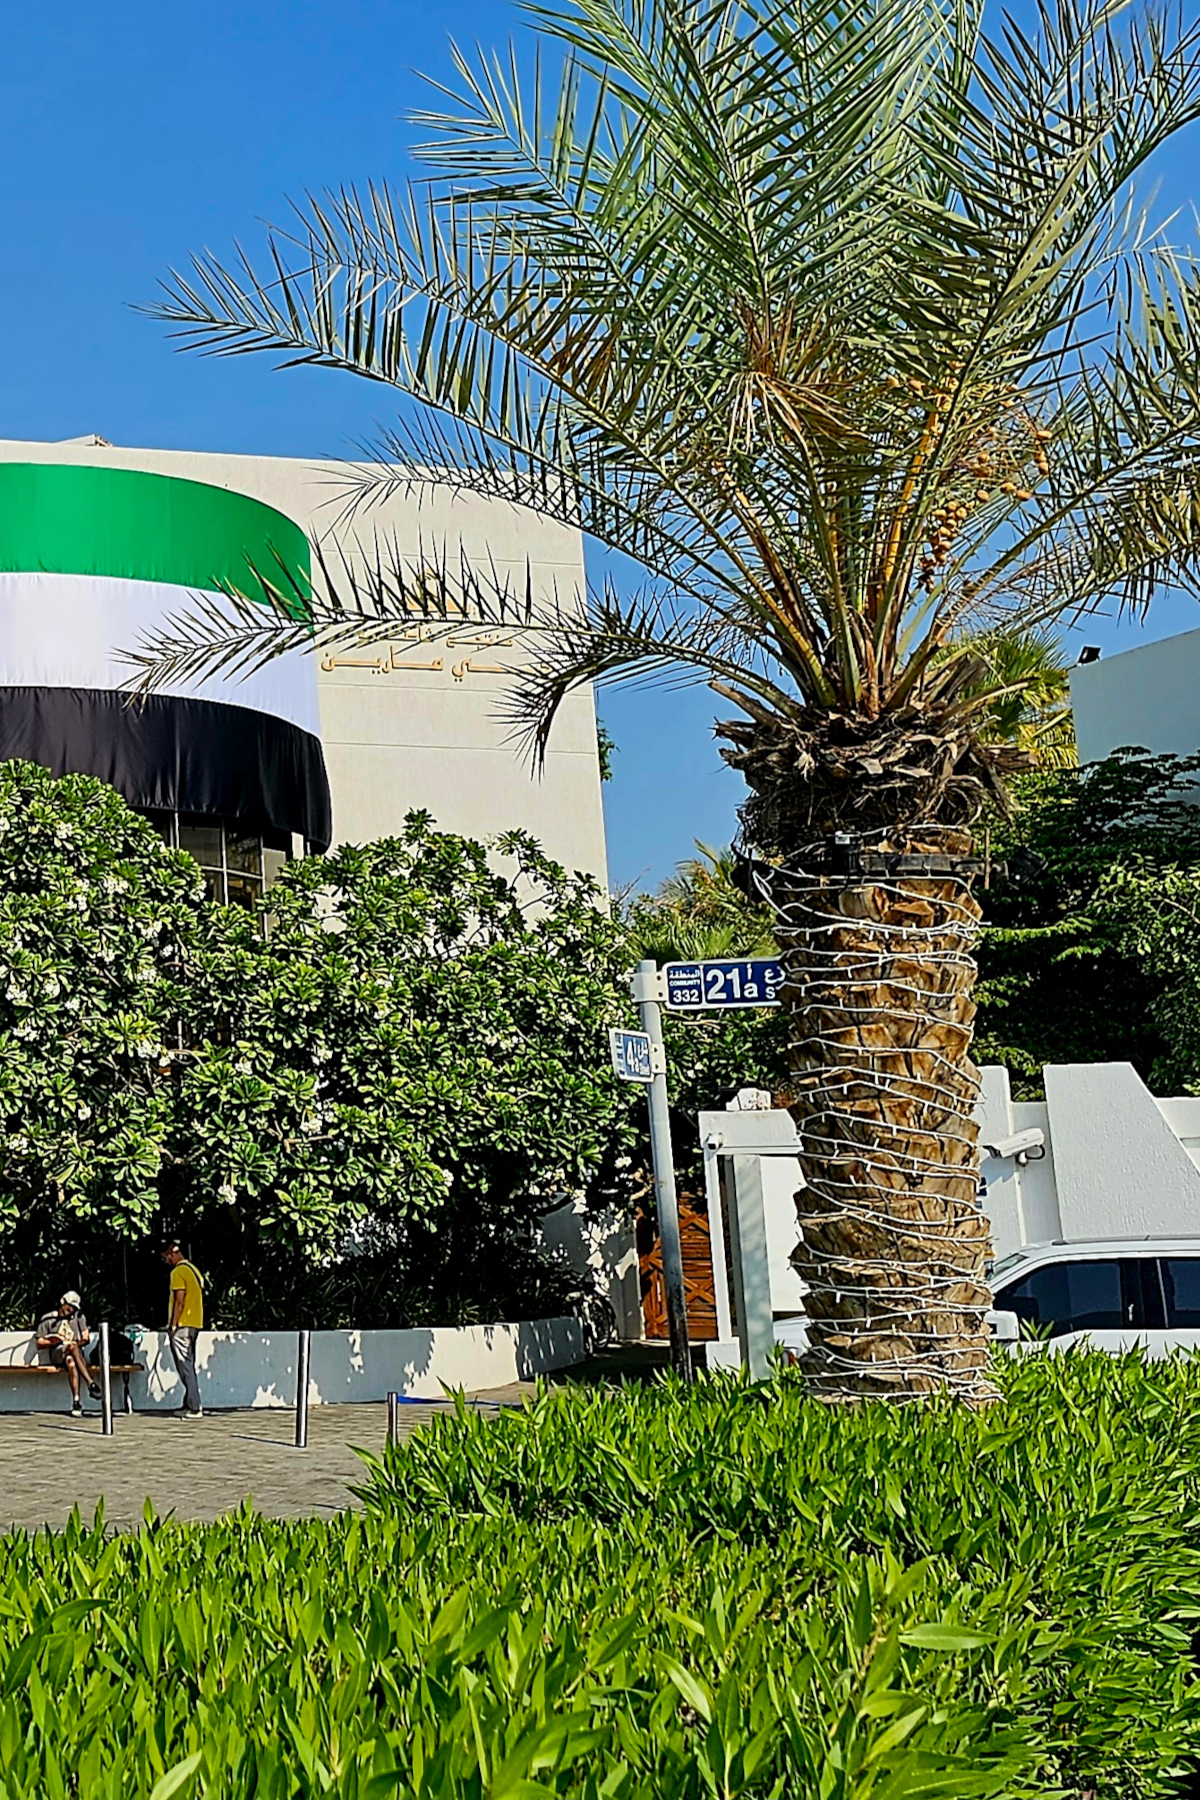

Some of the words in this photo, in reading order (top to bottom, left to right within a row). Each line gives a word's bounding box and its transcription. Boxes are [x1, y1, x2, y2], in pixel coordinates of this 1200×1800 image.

[320, 645, 444, 675] مارين
[669, 979, 700, 987] COMMUNITY
[673, 989, 700, 1003] 332
